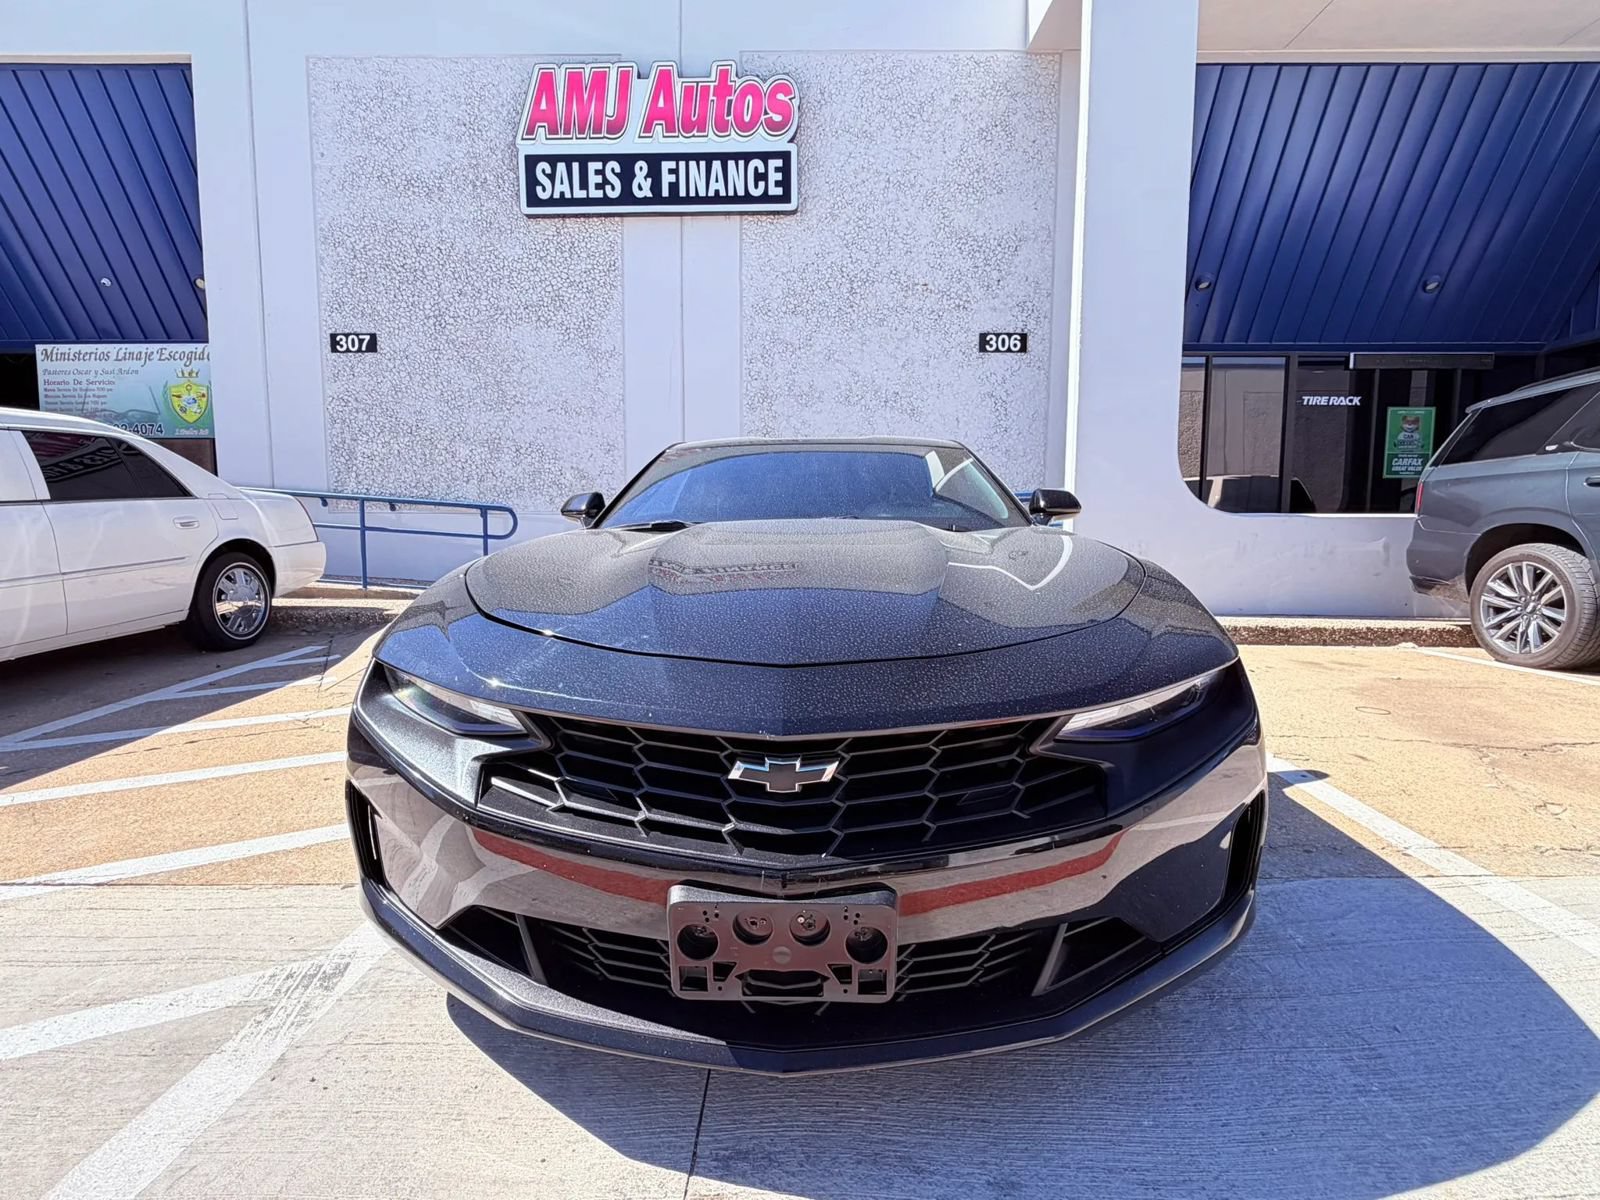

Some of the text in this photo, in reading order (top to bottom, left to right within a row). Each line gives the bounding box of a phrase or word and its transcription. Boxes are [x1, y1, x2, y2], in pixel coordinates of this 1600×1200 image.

[522, 65, 796, 140] AMJ Autos
[535, 158, 784, 200] SALES & FINANCE
[335, 334, 371, 351] 307
[985, 334, 1021, 351] 306
[40, 347, 110, 362] Ministerios
[113, 347, 155, 367] Linaje
[42, 368, 71, 376] Pastores
[72, 368, 92, 376] Oscar
[94, 370, 99, 378] y
[1302, 396, 1361, 406] TIRE RACK
[1391, 457, 1424, 466] CARFAX
